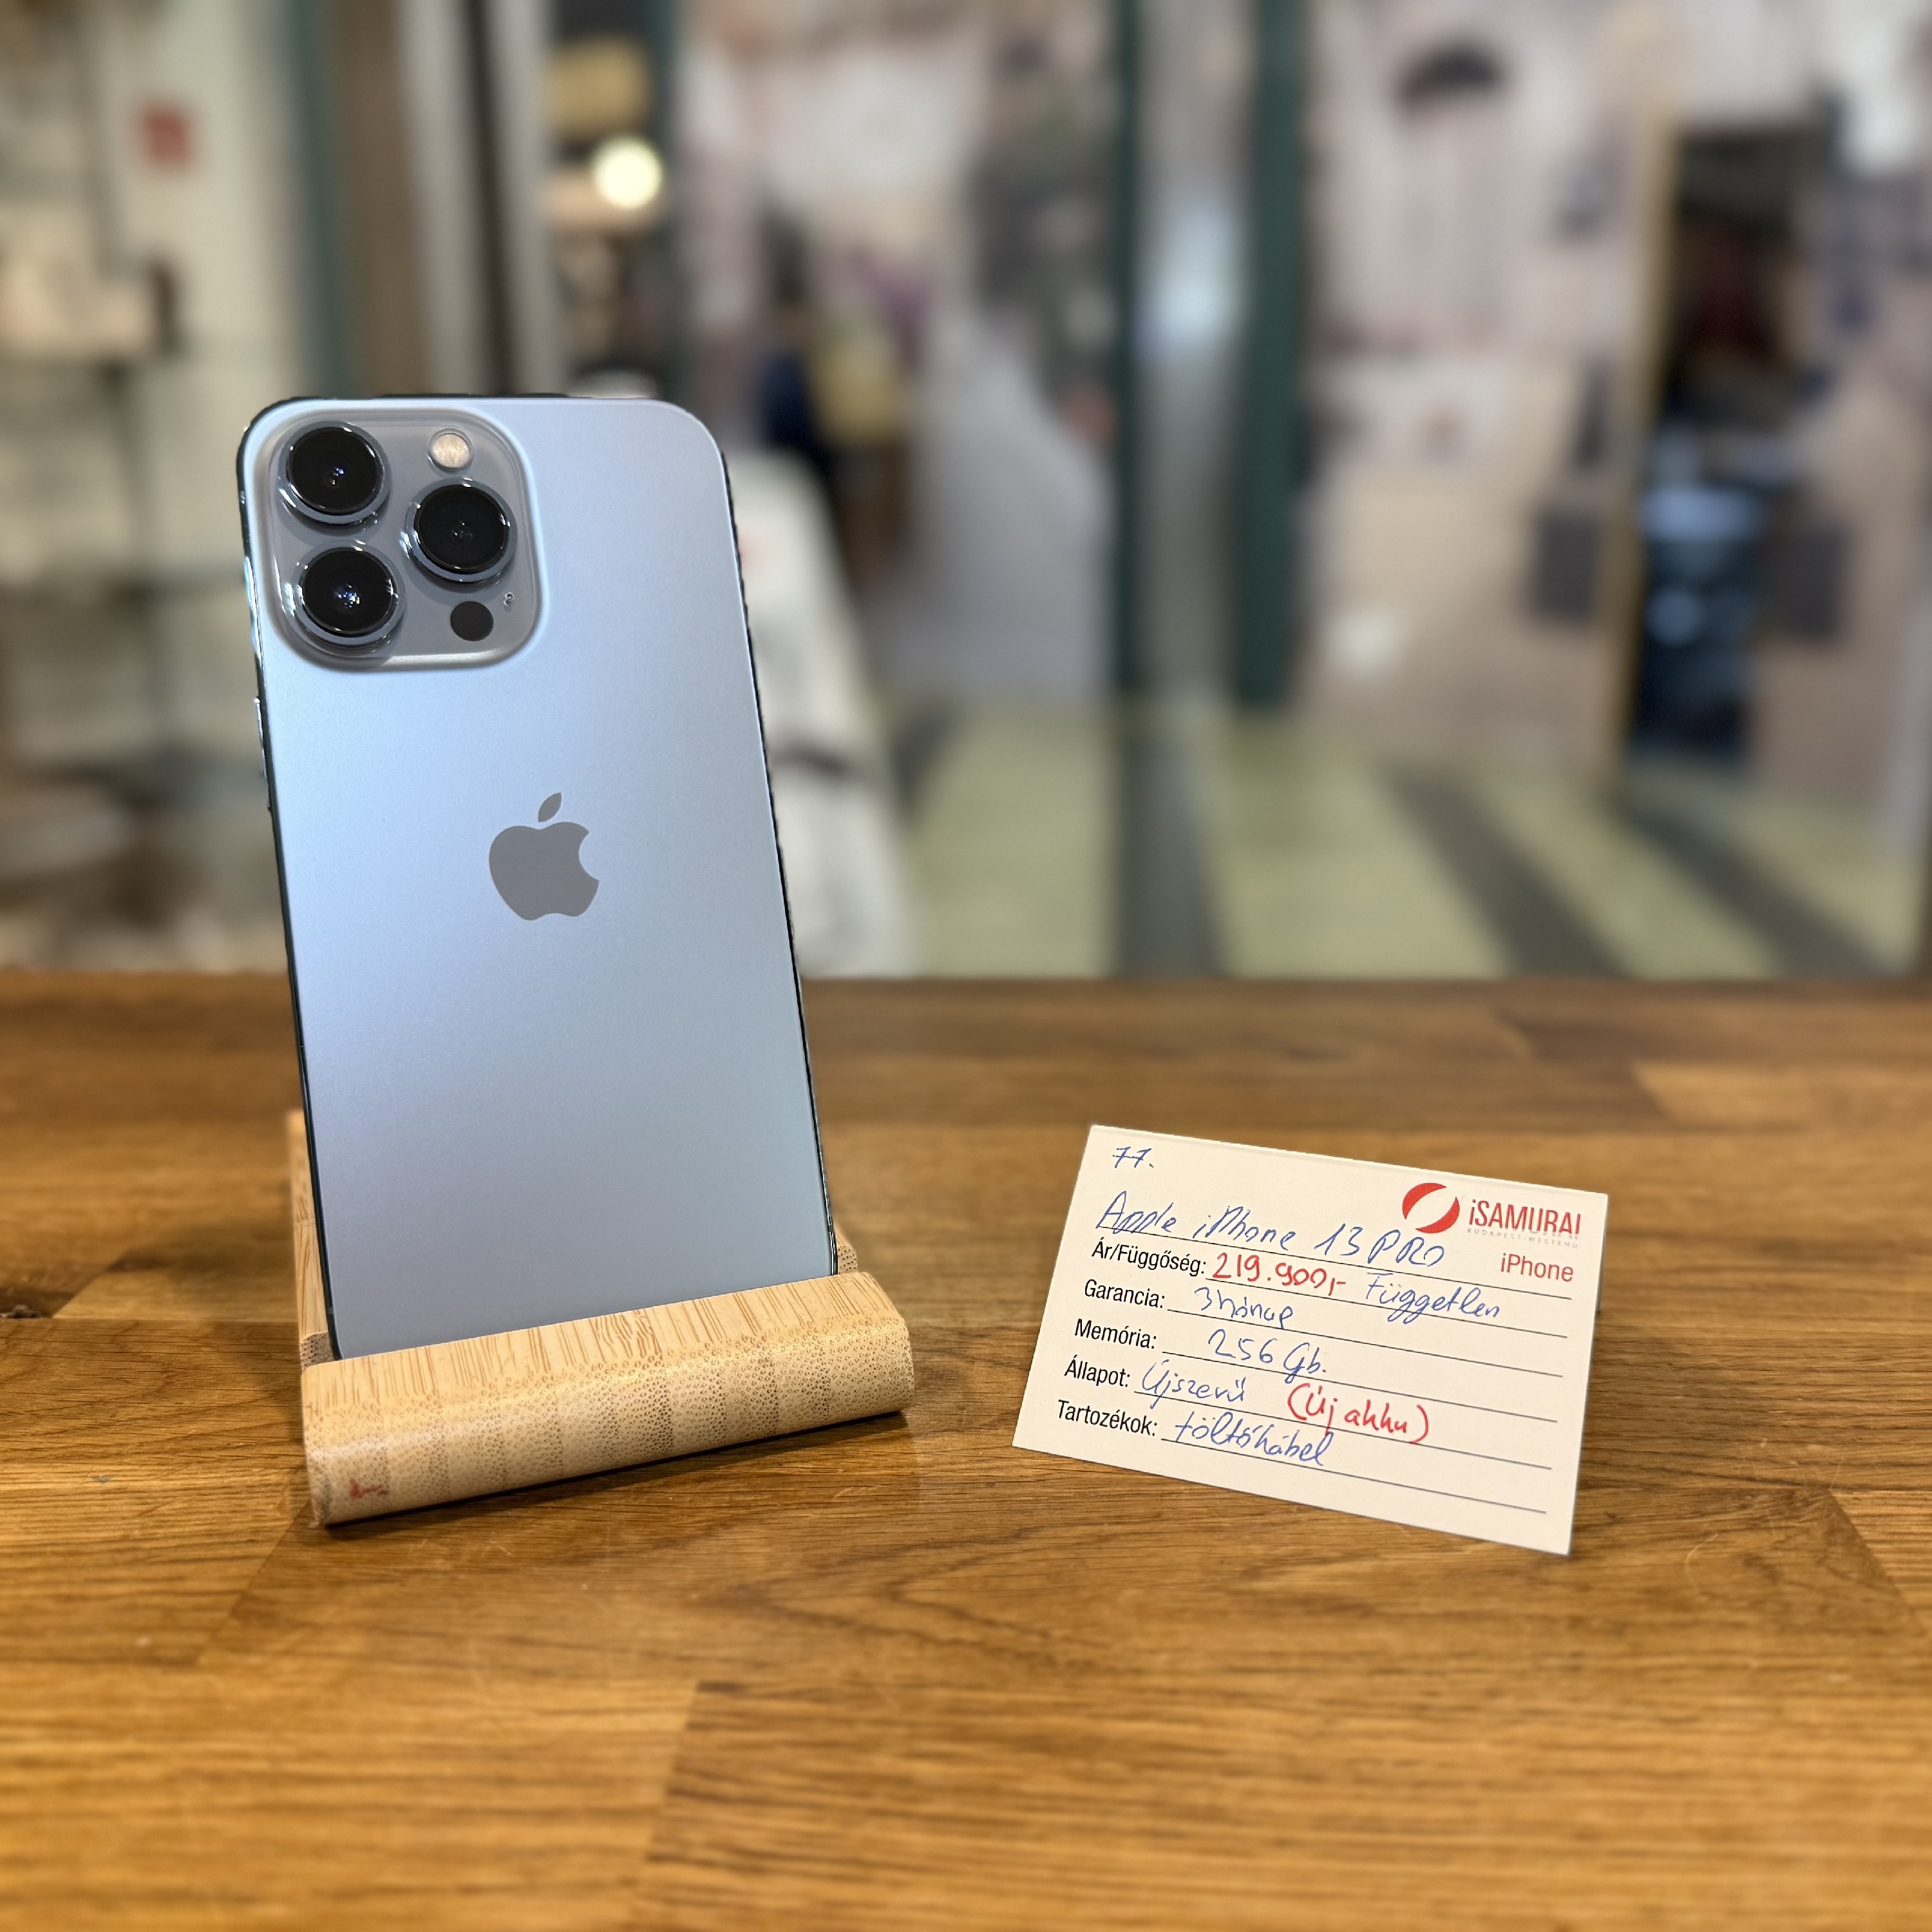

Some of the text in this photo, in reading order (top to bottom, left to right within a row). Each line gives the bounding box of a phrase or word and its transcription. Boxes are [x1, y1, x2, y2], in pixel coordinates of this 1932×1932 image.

[1113, 1146, 1154, 1169] 77.
[1095, 1190, 1445, 1267] Apple iPhone 13 PRO
[1469, 1199, 1581, 1235] iSAMURAI
[1092, 1237, 1207, 1277] Ár/Függőség:
[1366, 1271, 1501, 1325] Független
[1501, 1253, 1573, 1282] iPhone
[1084, 1278, 1166, 1309] Garancia:
[1194, 1287, 1213, 1311] 3
[1074, 1318, 1157, 1350] Memória:
[1208, 1329, 1278, 1365] 256
[1064, 1354, 1130, 1388] Állapot:
[1057, 1399, 1158, 1437] Tartozékok:
